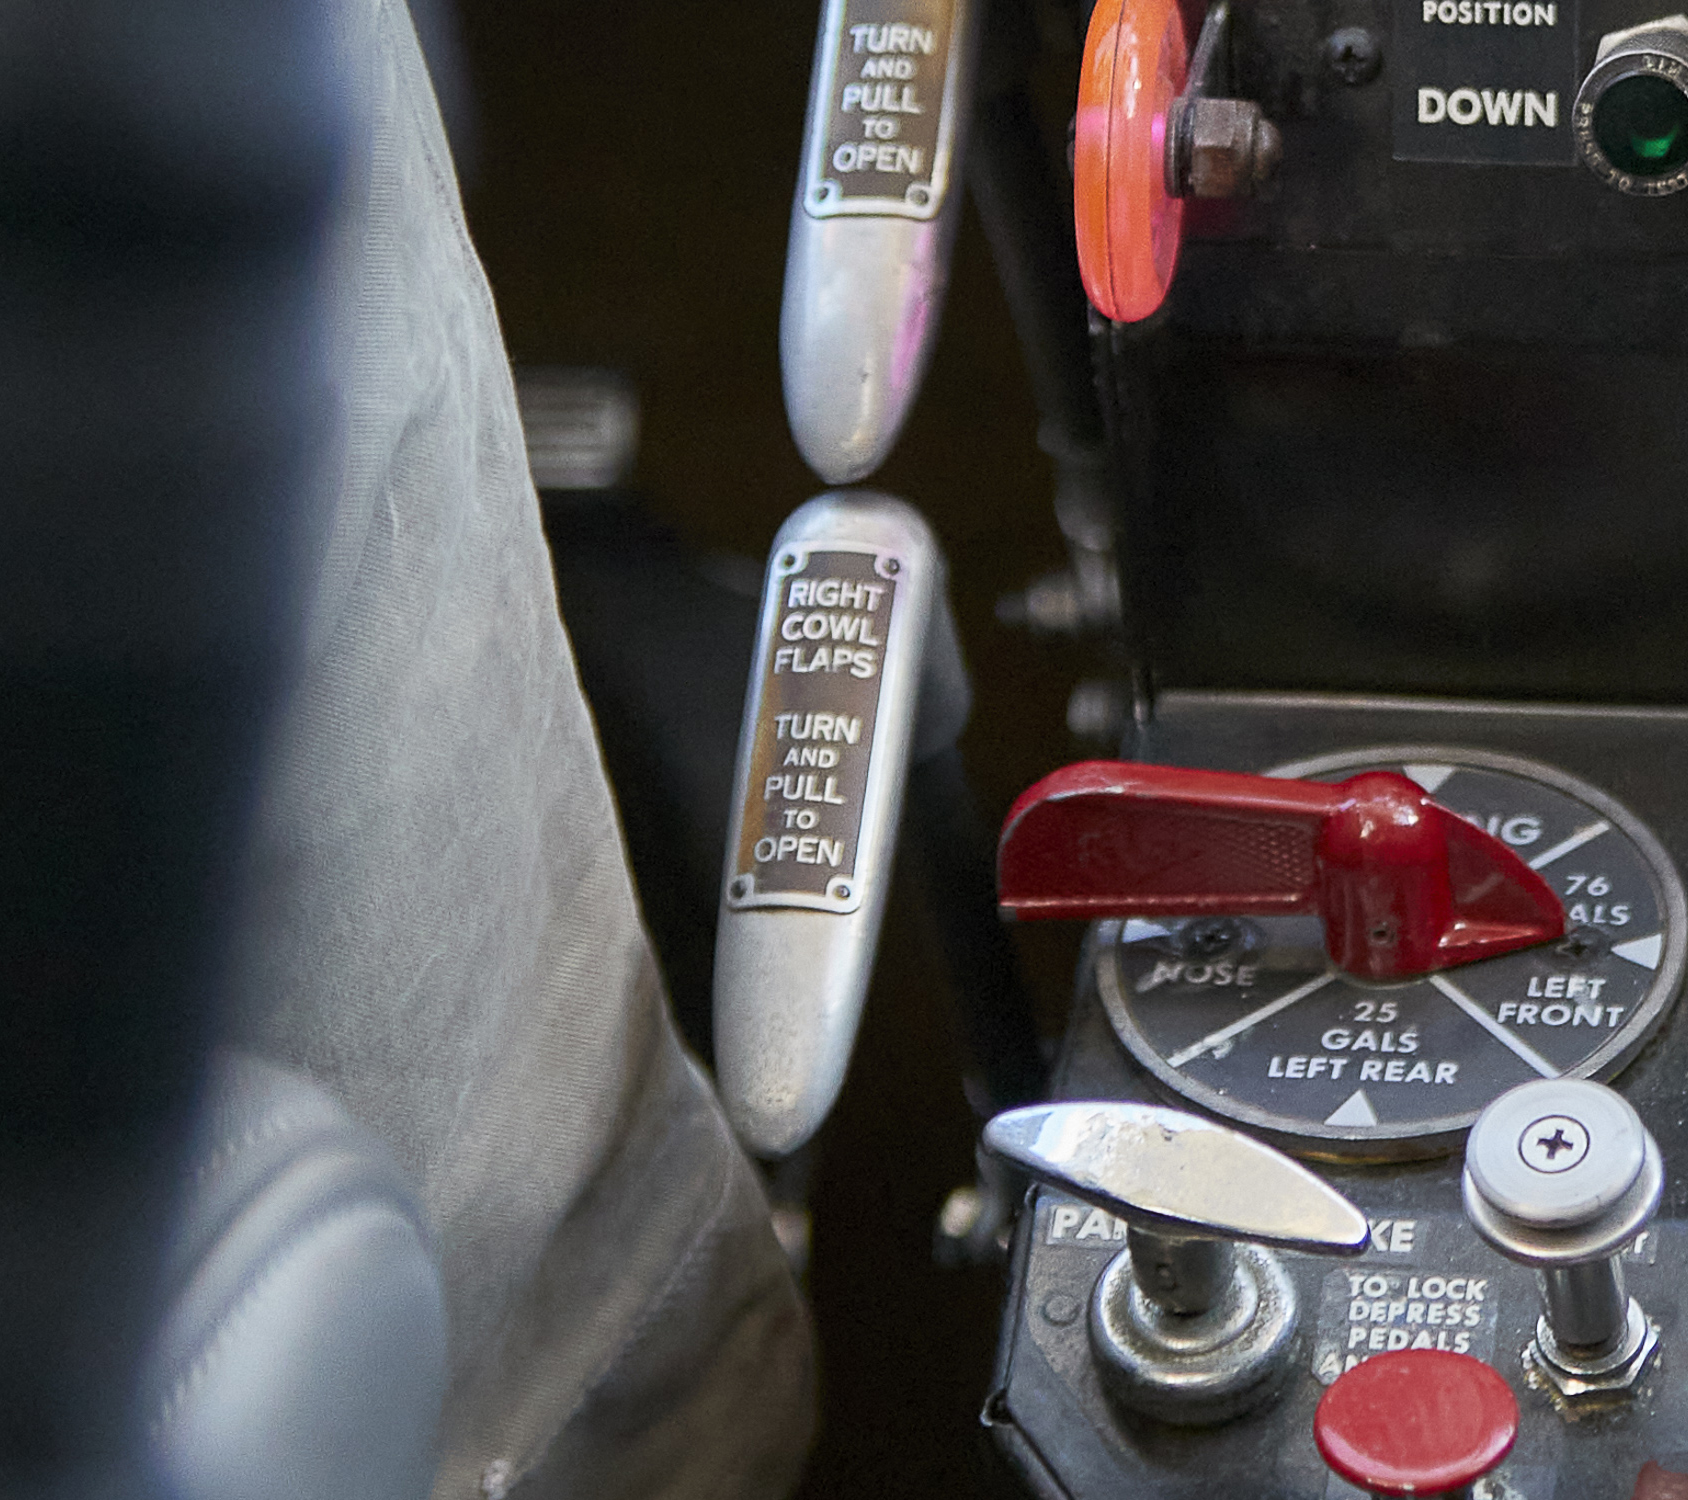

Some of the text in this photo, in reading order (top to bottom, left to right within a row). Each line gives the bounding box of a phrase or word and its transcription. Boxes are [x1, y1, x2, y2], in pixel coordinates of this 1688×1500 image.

[1422, 0, 1557, 26] POSITION
[849, 23, 934, 55] TURN
[860, 57, 915, 80] AND
[842, 83, 922, 115] PULL
[1418, 88, 1558, 127] DOWN
[863, 116, 896, 139] TO
[833, 143, 922, 175] OPEN
[788, 579, 886, 611] RIGHT
[782, 614, 879, 646] COWL
[774, 646, 877, 679] FLAPS
[774, 713, 860, 745] TURN
[783, 749, 838, 769] AND
[764, 775, 845, 805] PULL
[784, 808, 818, 829] TO
[754, 837, 844, 867] OPEN
[1565, 875, 1609, 896] 76
[1152, 962, 1256, 987] NOSE
[1527, 976, 1605, 1000] LEFT
[1354, 1002, 1398, 1024] 25
[1496, 1003, 1624, 1028] FRONT
[1321, 1029, 1419, 1054] GALS
[1268, 1056, 1458, 1084] LEFT REAR
[1349, 1276, 1487, 1300] TO LOCK
[1349, 1301, 1481, 1326] DEPRESS
[1347, 1328, 1470, 1352] PEDALS
